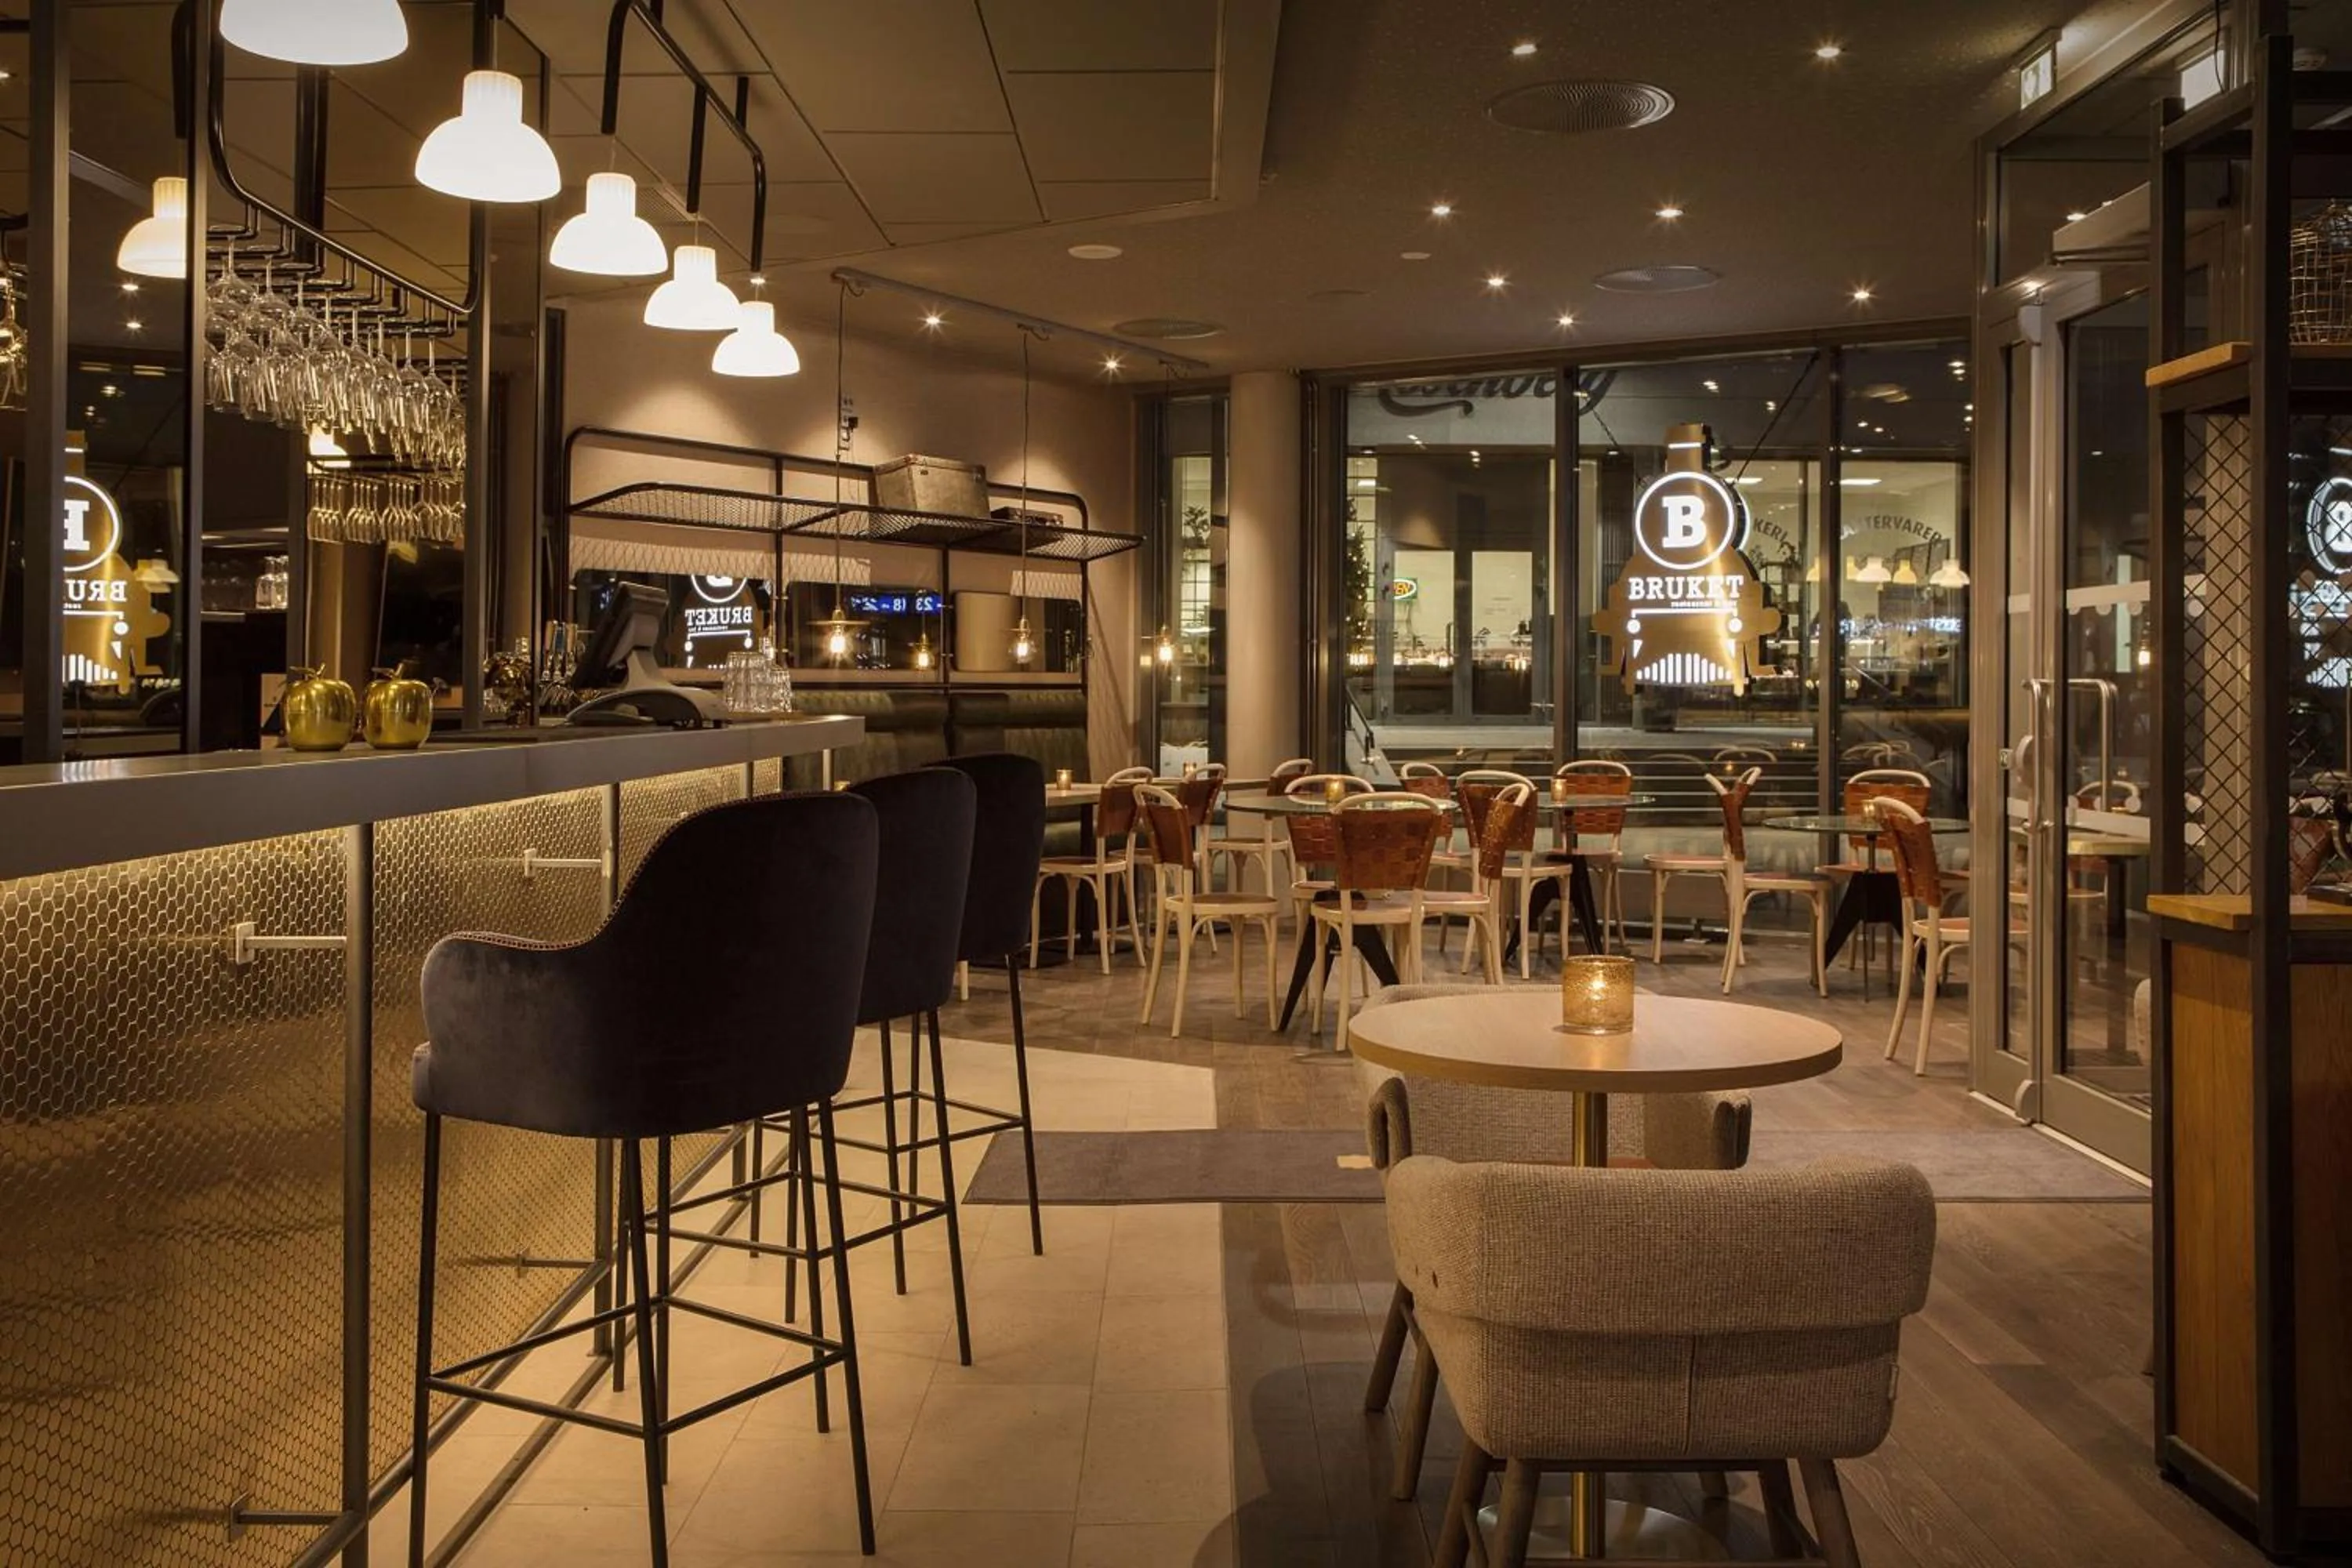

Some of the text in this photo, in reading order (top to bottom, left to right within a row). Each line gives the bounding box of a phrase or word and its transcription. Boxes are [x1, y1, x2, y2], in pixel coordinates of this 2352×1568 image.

[1662, 495, 1706, 547] B
[1753, 517, 1788, 543] KERI
[1628, 575, 1744, 601] BRUKET
